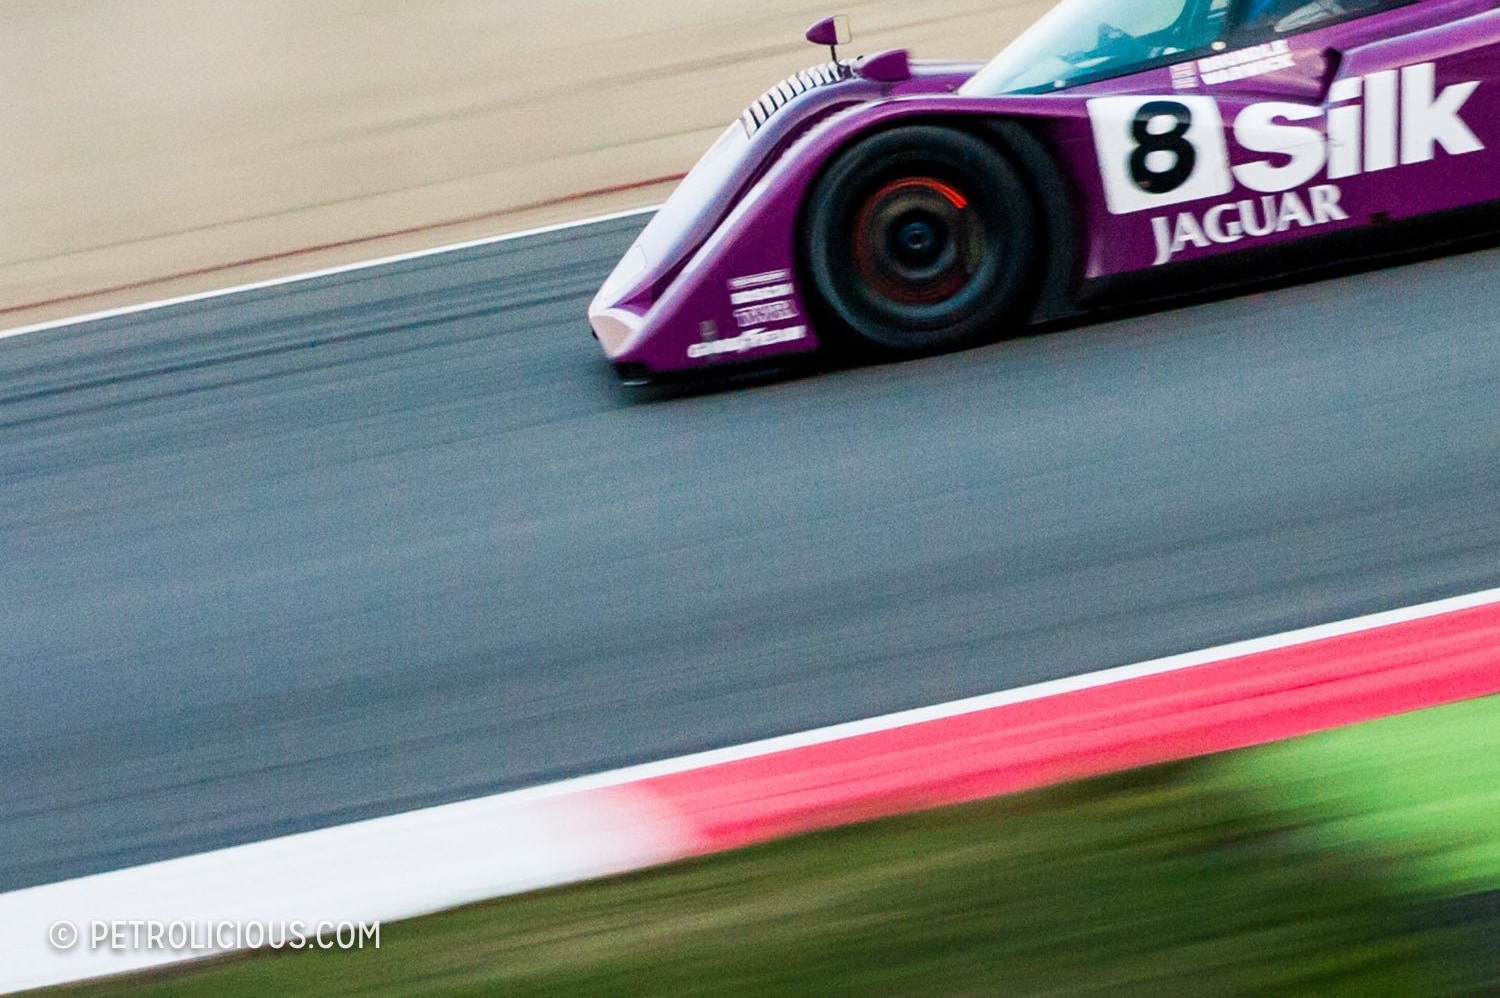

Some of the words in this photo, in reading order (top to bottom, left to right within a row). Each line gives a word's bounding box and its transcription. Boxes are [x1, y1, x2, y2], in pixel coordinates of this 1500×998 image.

[1127, 100, 1197, 194] 8
[1231, 61, 1485, 193] Silk
[1151, 184, 1350, 266] JAGUAR
